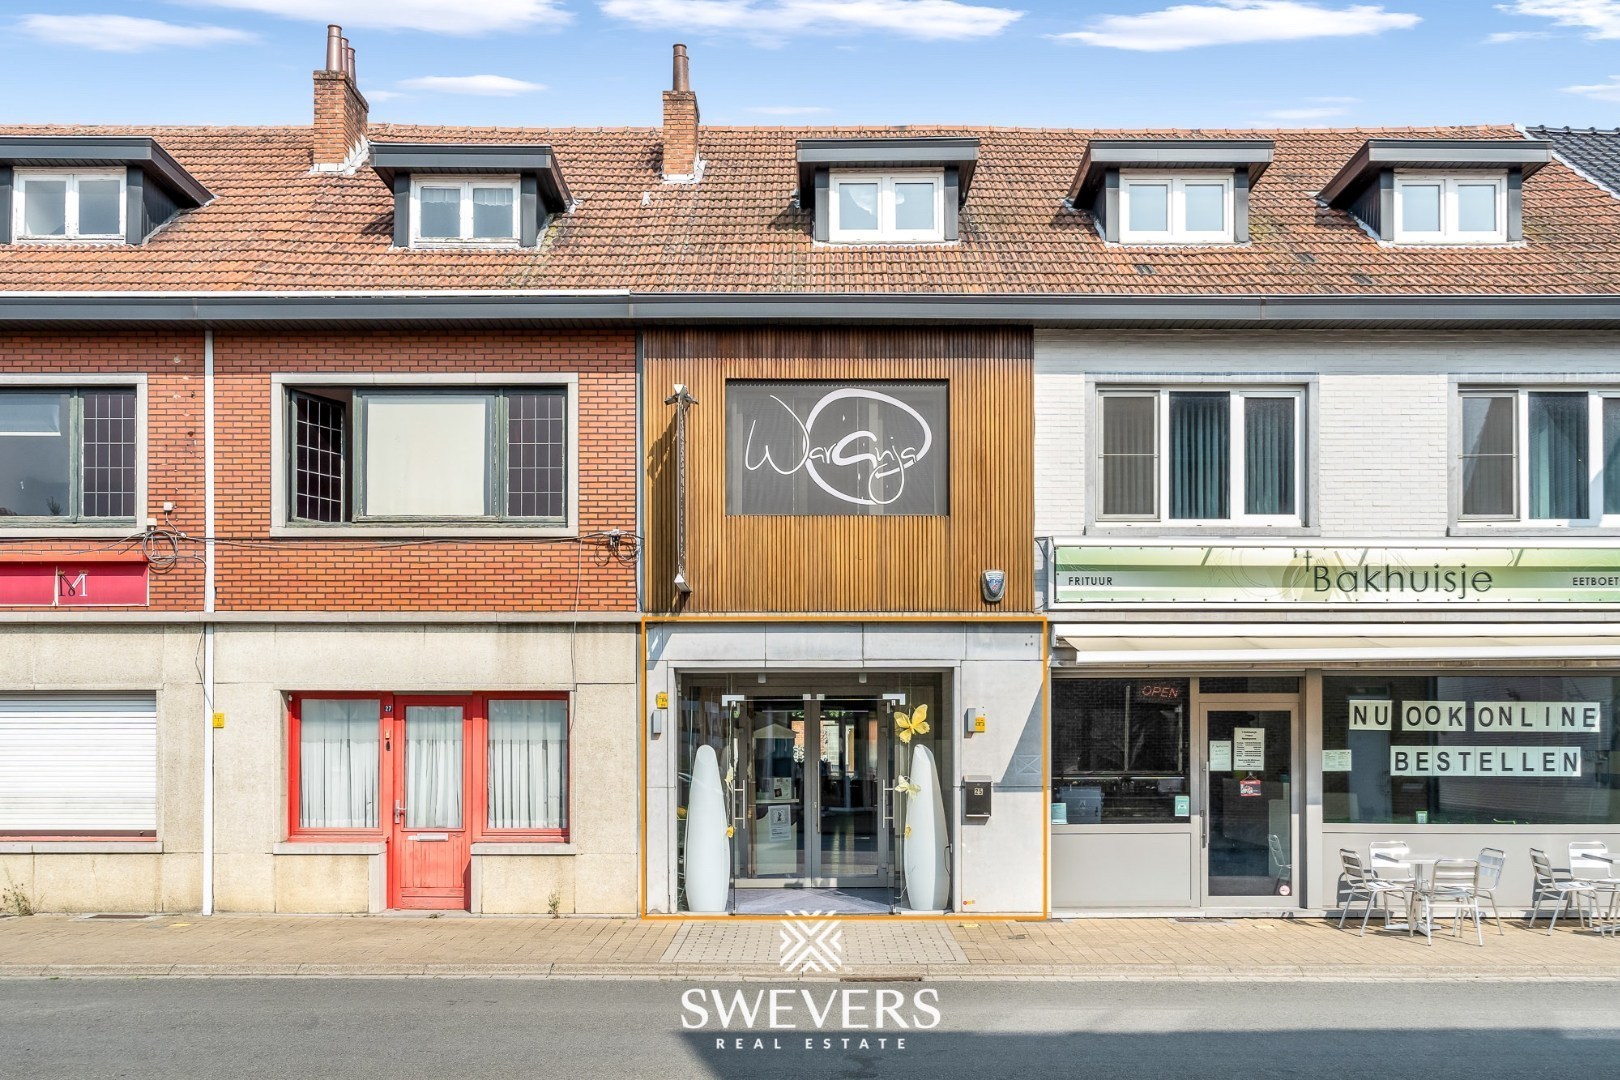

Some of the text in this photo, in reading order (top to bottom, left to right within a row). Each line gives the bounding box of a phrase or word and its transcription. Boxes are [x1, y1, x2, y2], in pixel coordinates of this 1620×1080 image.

[1068, 576, 1113, 586] FRITUUR
[1313, 563, 1493, 599] Bakhuisje
[1572, 576, 1619, 586] EETBOET
[1142, 685, 1178, 698] OPEN
[1353, 704, 1597, 728] NU OOK ONLINE
[1394, 751, 1577, 772] BESTELLEN
